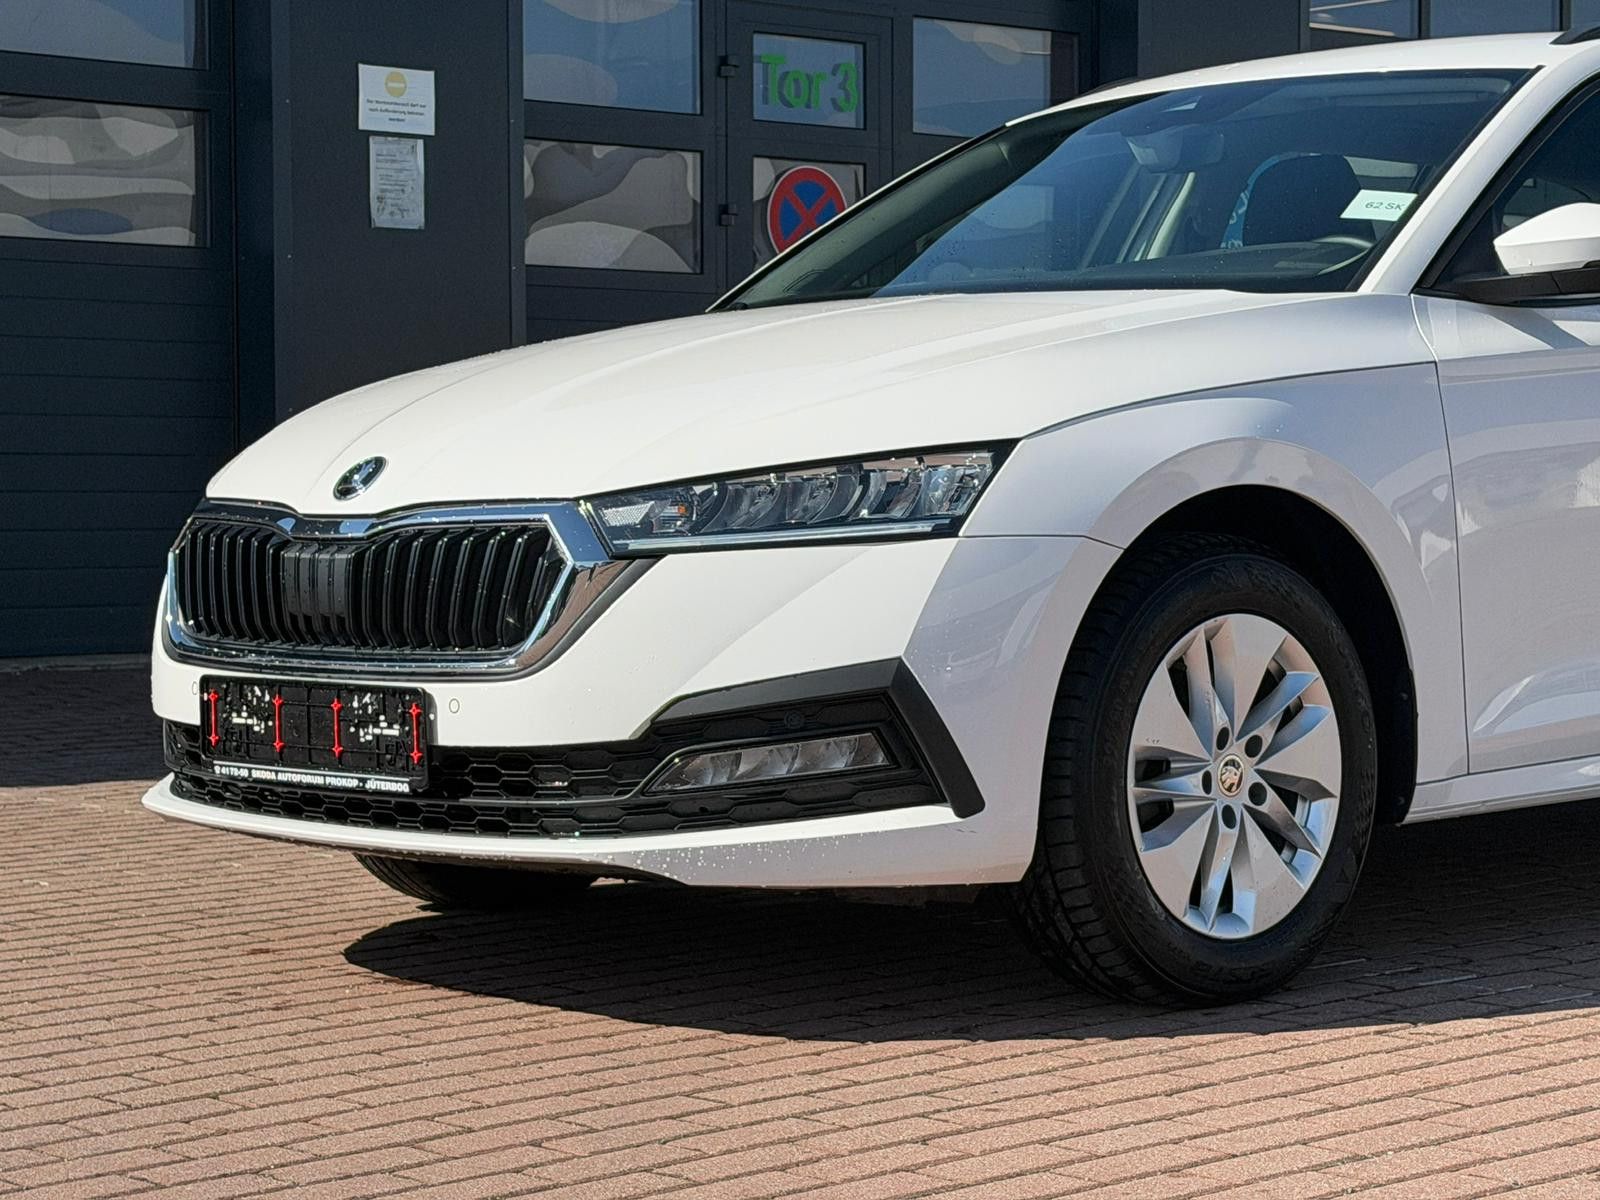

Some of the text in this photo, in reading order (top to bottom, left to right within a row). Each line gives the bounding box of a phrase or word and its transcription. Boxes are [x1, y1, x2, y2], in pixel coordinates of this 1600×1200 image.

[759, 53, 859, 113] Tor 3
[1365, 201, 1406, 211] 62 SK
[277, 772, 325, 785] AUTOFORUM
[325, 775, 359, 788] PROKOP
